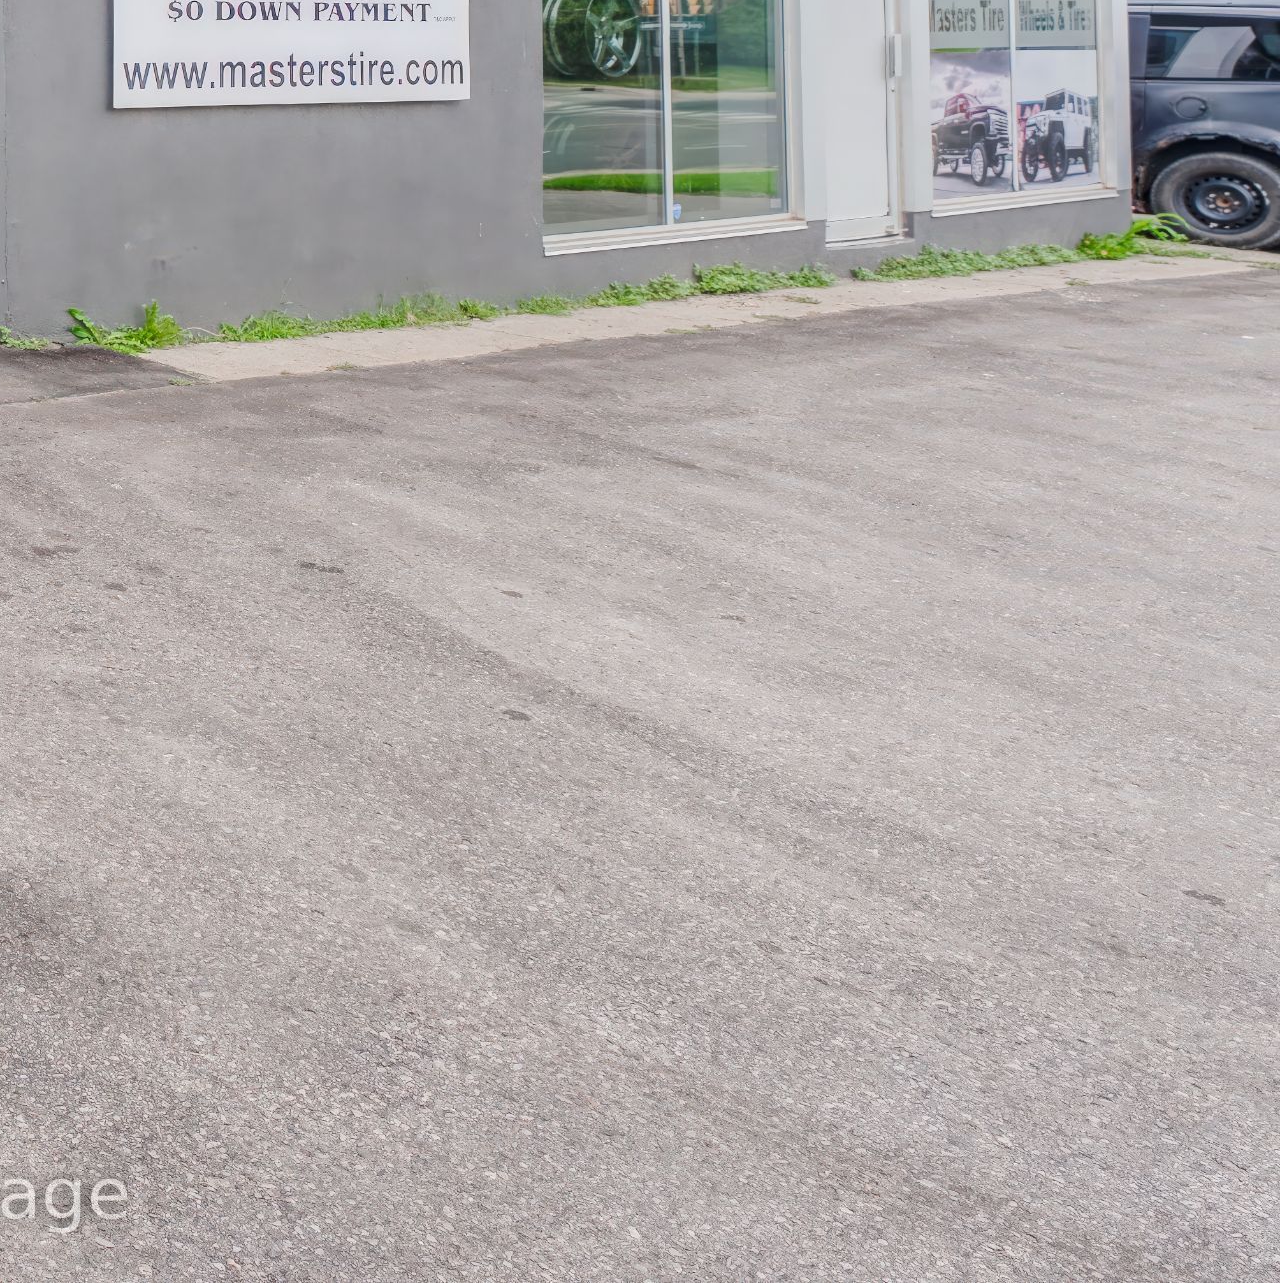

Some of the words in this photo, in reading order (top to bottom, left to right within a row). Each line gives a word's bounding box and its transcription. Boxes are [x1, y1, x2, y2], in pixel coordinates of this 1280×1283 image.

[167, 0, 204, 23] $0
[215, 0, 302, 22] DOWN
[313, 2, 432, 22] PAYMENT
[979, 0, 1005, 32] Tire
[1018, 0, 1055, 32] Wheels
[1058, 0, 1065, 31] &
[122, 51, 464, 90] www.masterstire.com
